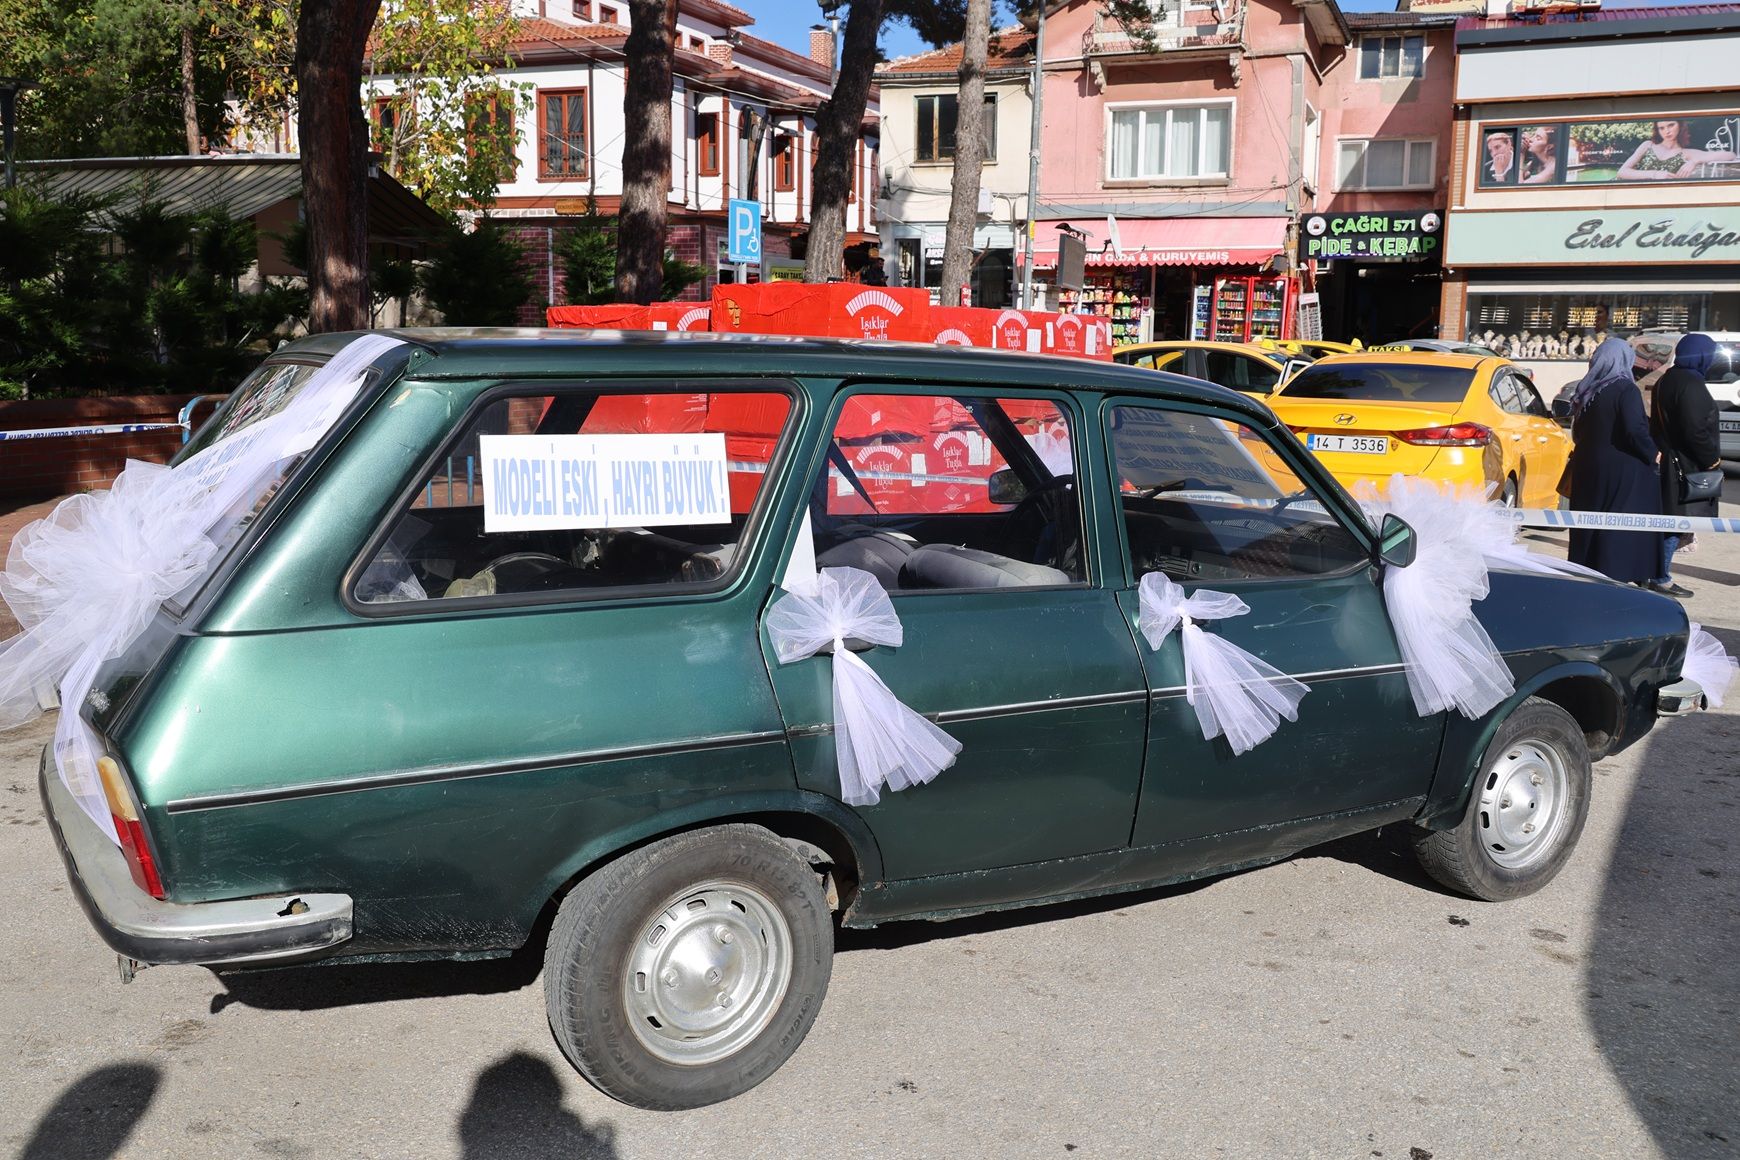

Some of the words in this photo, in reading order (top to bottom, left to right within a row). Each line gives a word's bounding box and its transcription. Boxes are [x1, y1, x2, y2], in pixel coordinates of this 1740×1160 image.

[735, 206, 753, 254] P
[1331, 215, 1389, 236] ÇAĞRI
[1393, 219, 1417, 232] 571
[1308, 236, 1353, 256] PİDE
[1357, 240, 1367, 251] &
[1369, 236, 1437, 255] KEBAP
[1139, 252, 1149, 262] &
[1152, 250, 1230, 263] KURUYEMİŞ
[860, 315, 889, 332] Işıklar
[1316, 437, 1329, 449] 14
[1338, 438, 1345, 449] T
[1352, 438, 1384, 452] 3536
[492, 442, 558, 517] MODELİ
[560, 443, 599, 517] ESKİ
[611, 460, 660, 516] HAYRI
[662, 444, 717, 516] BÜYÜK
